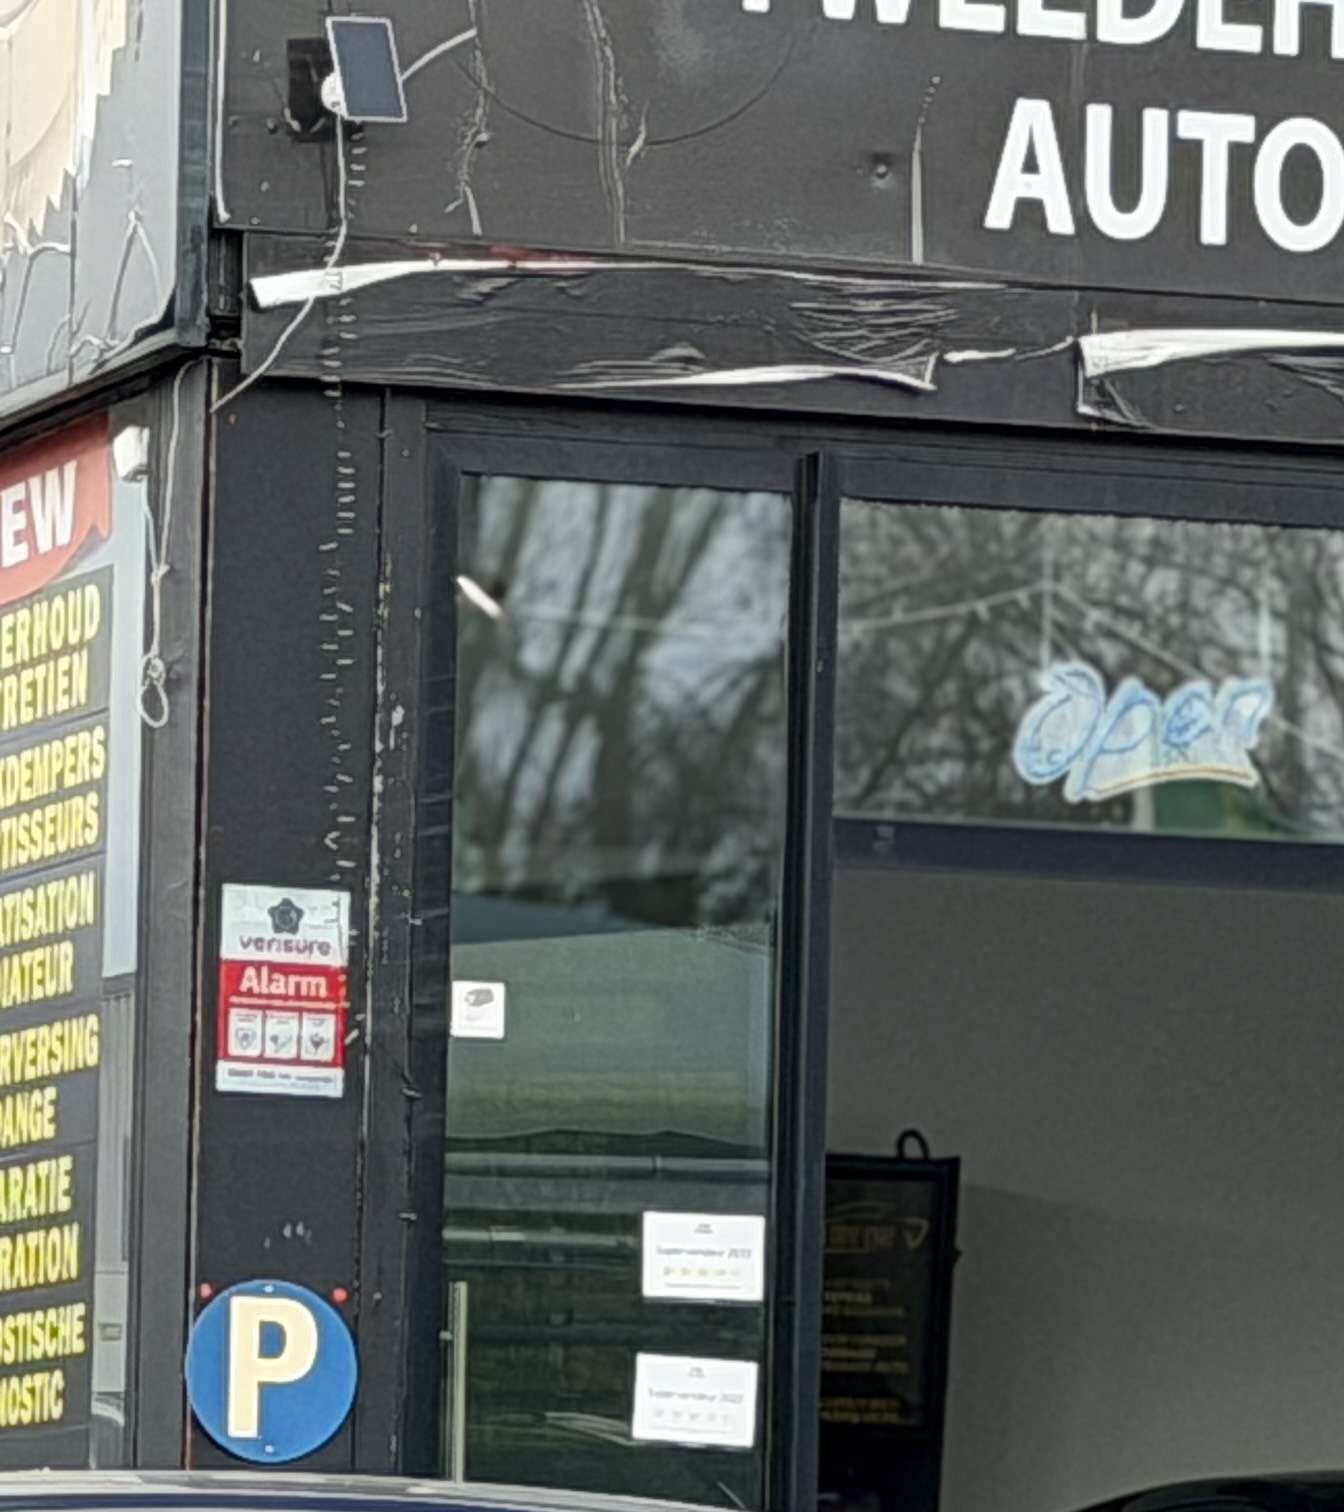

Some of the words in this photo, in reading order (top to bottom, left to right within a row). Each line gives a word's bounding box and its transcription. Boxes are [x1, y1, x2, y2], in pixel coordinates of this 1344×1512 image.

[239, 935, 332, 957] verisure
[239, 965, 328, 999] Alarm
[226, 1295, 320, 1439] P
